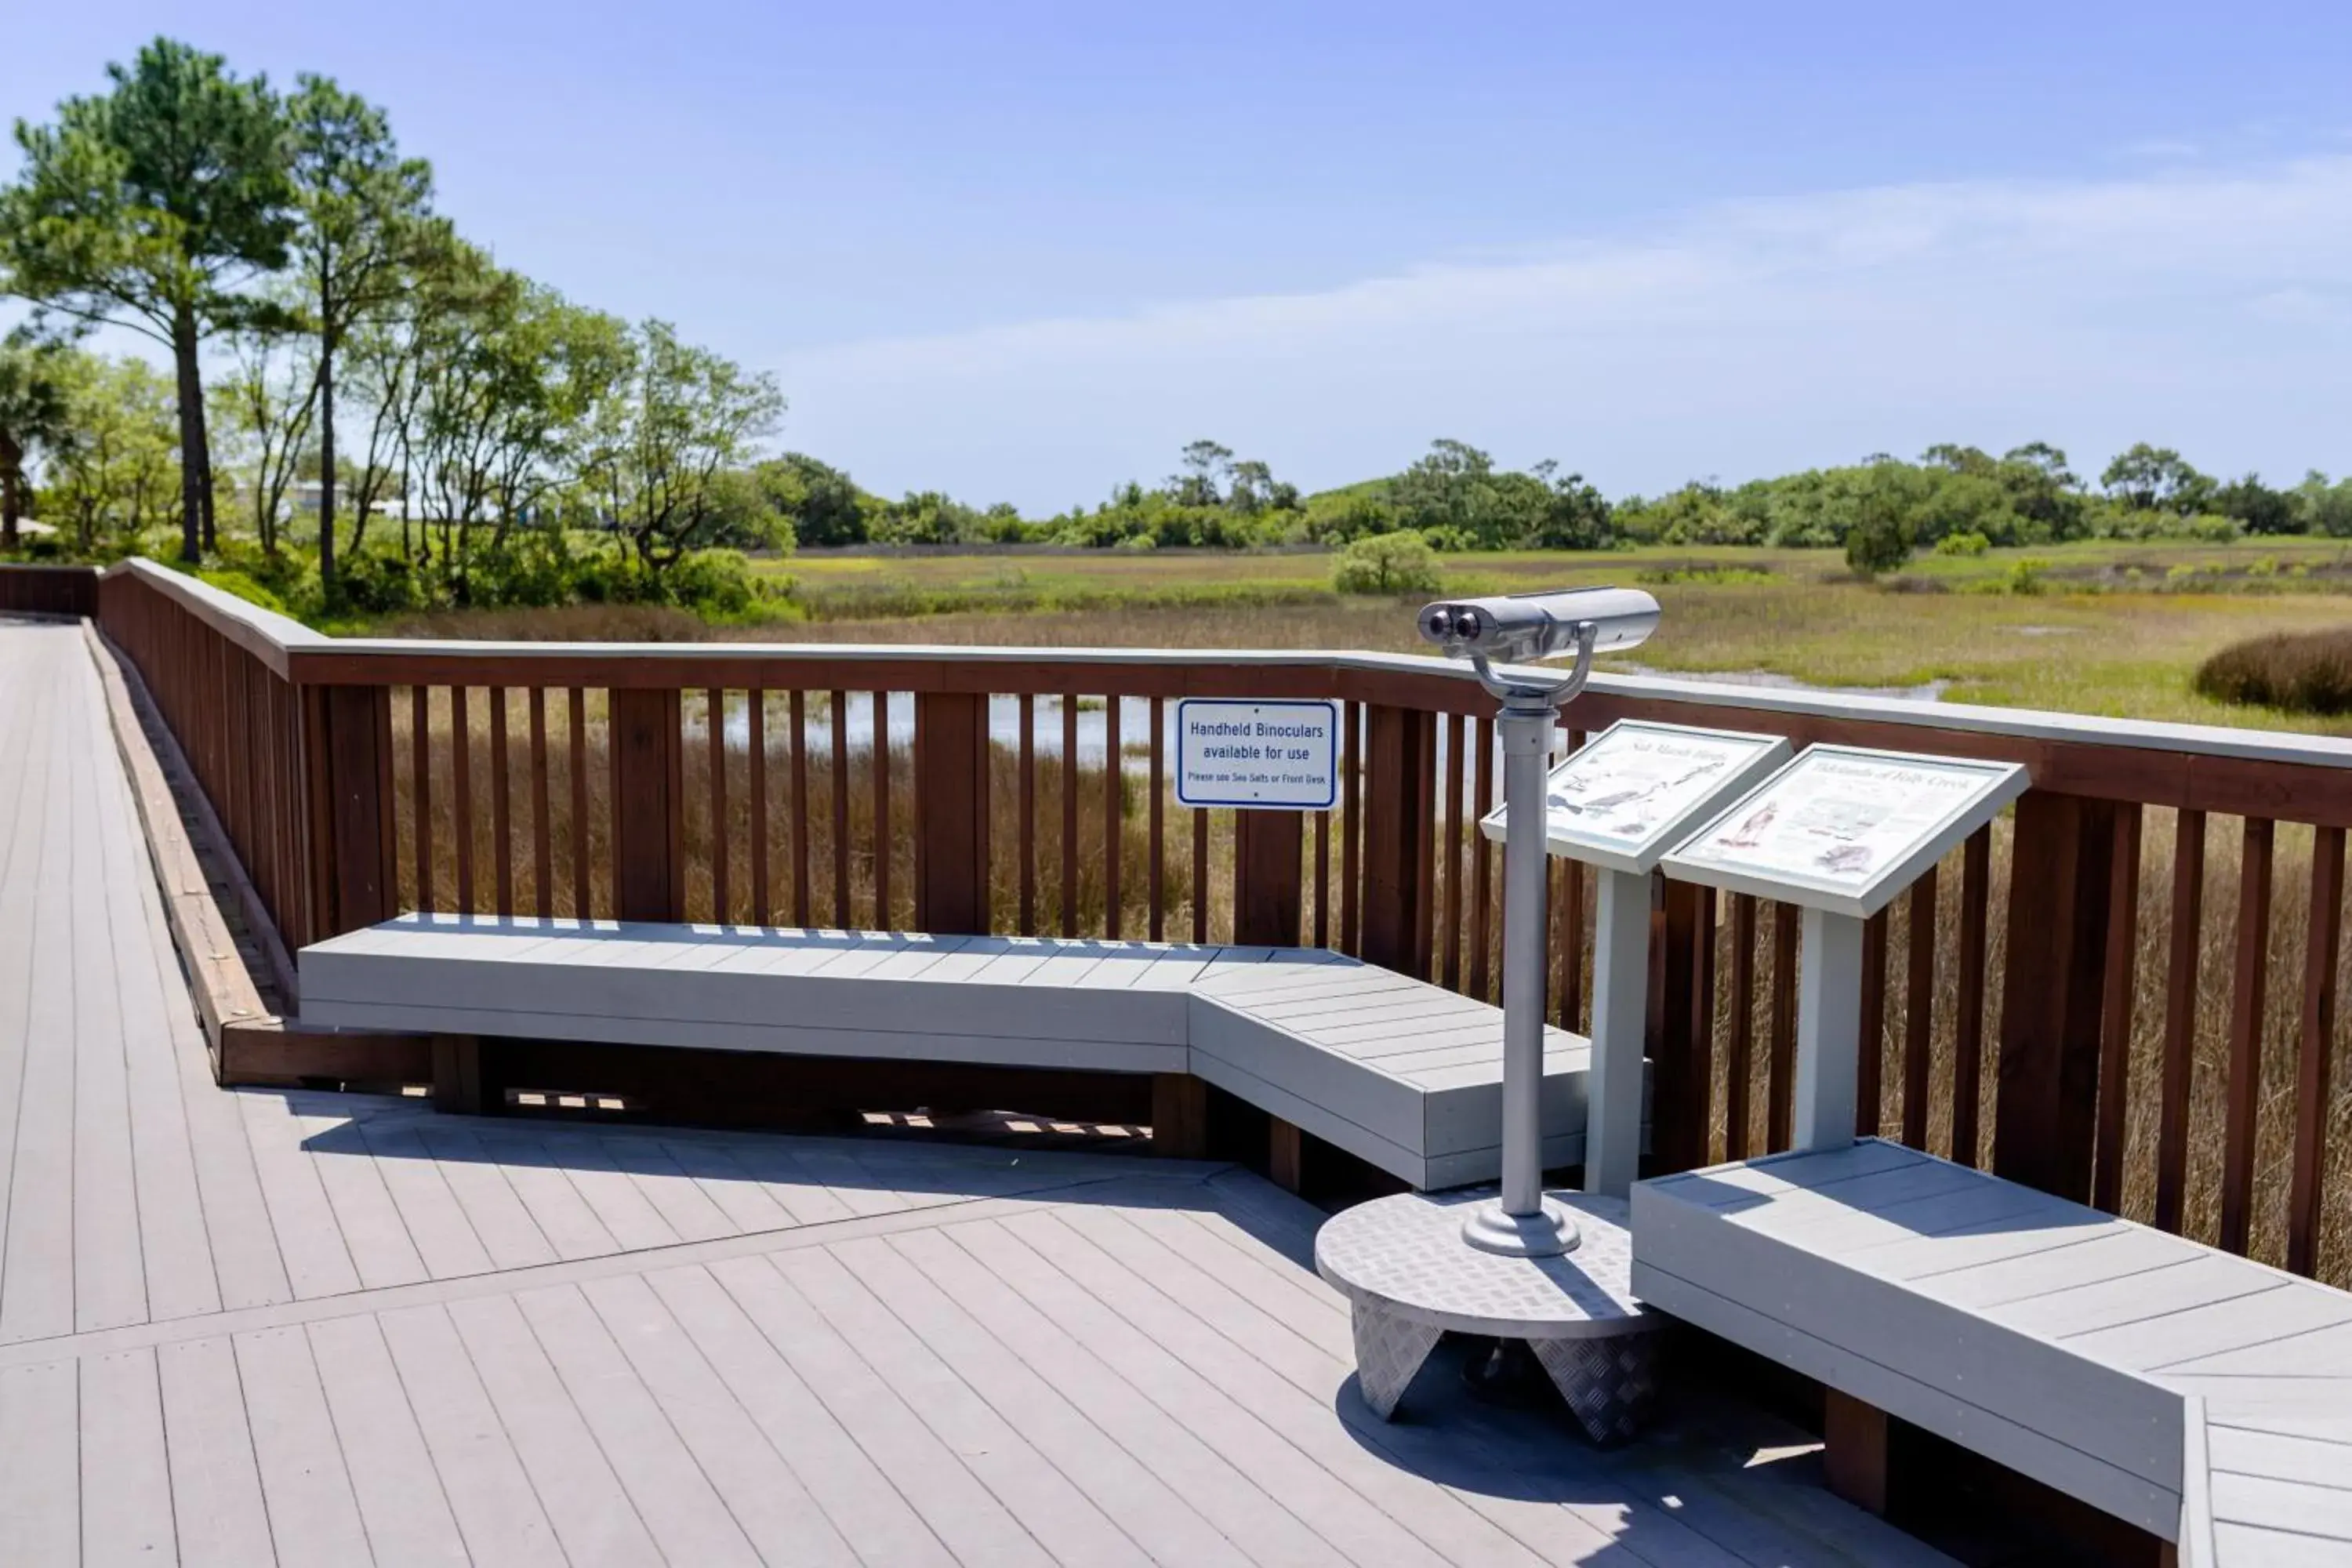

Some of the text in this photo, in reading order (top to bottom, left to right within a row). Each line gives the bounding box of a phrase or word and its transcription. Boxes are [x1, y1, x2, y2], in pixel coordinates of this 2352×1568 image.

[1191, 721, 1324, 738] Handheld Binoculars
[1203, 745, 1309, 760] available for use
[1188, 771, 1213, 782] Please
[1216, 773, 1229, 782] see
[1272, 775, 1279, 783] or
[1282, 774, 1303, 784] Front
[1306, 774, 1326, 785] Desk
